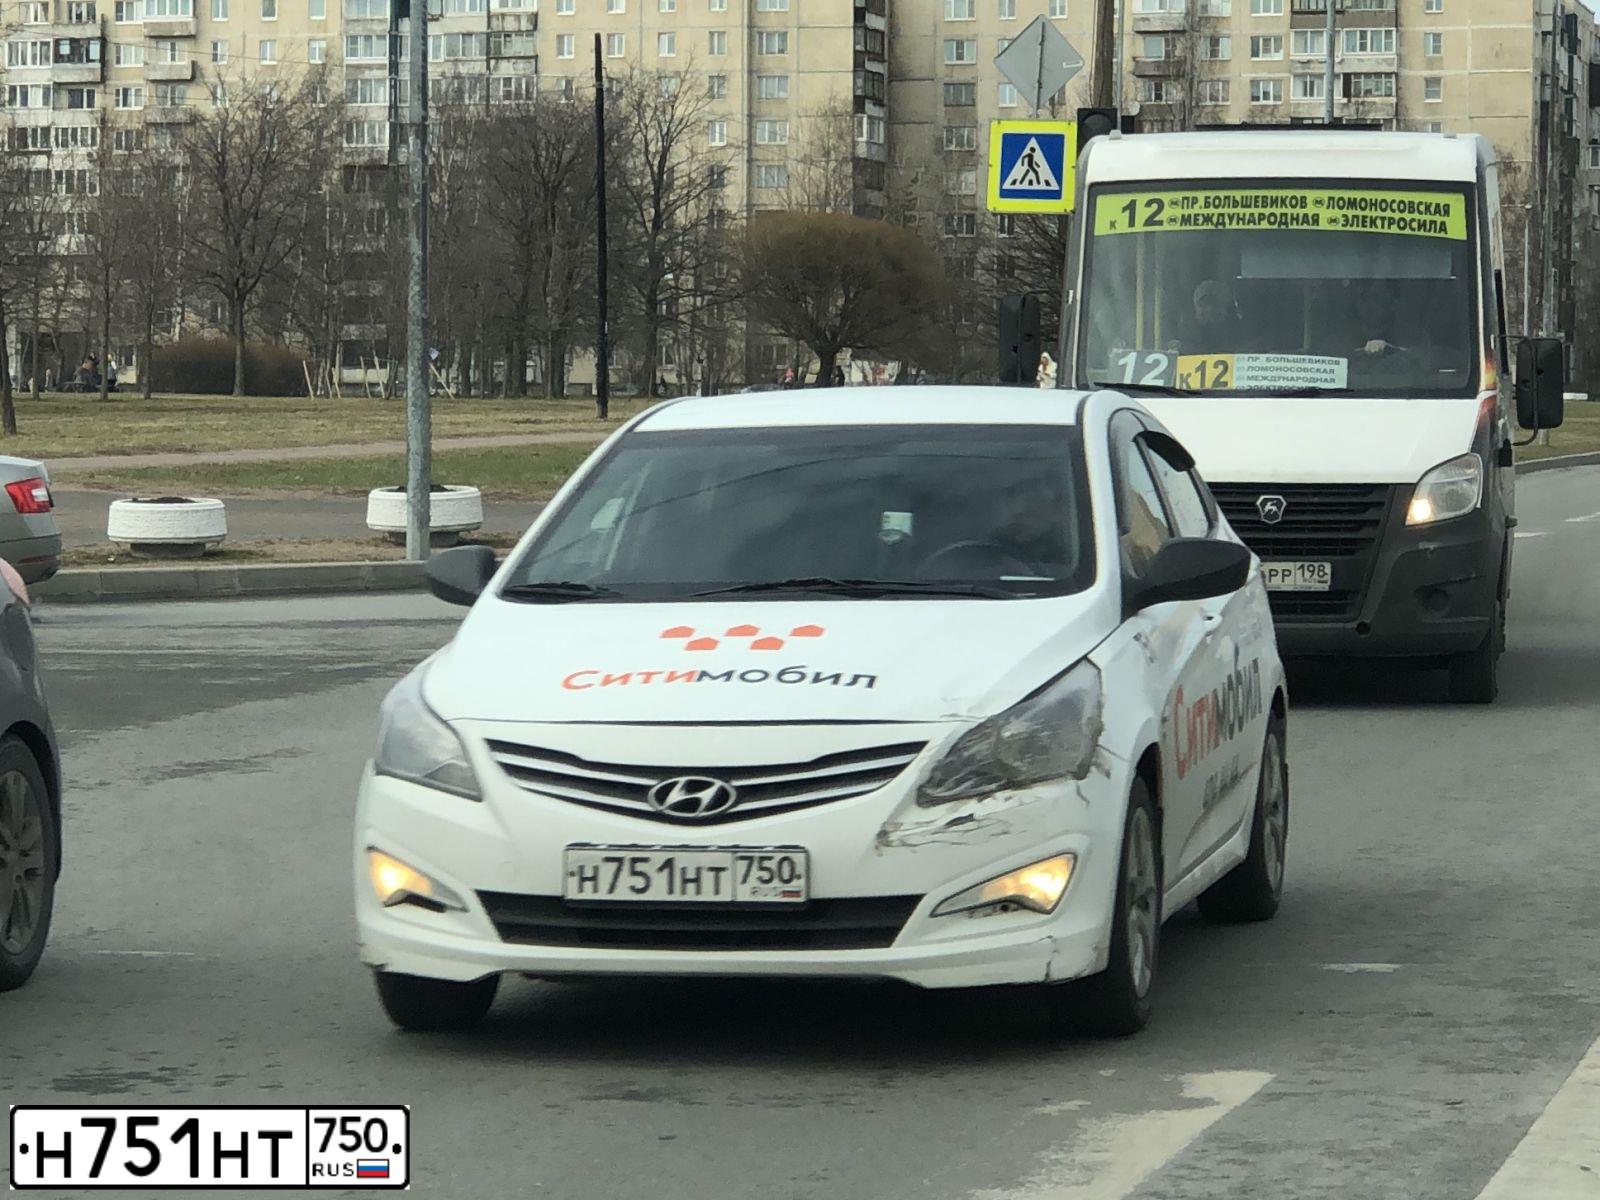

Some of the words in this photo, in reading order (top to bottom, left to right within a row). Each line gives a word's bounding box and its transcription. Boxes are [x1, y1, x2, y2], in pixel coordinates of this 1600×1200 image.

[1326, 196, 1451, 218] ЛОМОНОСОВСКАЯ
[1179, 212, 1320, 228] МЕЖДУНАРОДНАЯ
[1341, 213, 1448, 235] ЭЛЕКТРОСИЛА
[1118, 351, 1169, 386] 12
[1246, 365, 1335, 375] ЛОМОНОСОВСКАЯ
[1246, 374, 1336, 384] МЕЖДУНАРОДНАЯ
[1297, 563, 1326, 579] 198
[561, 664, 878, 691] Ситимобил
[736, 855, 797, 885] 750
